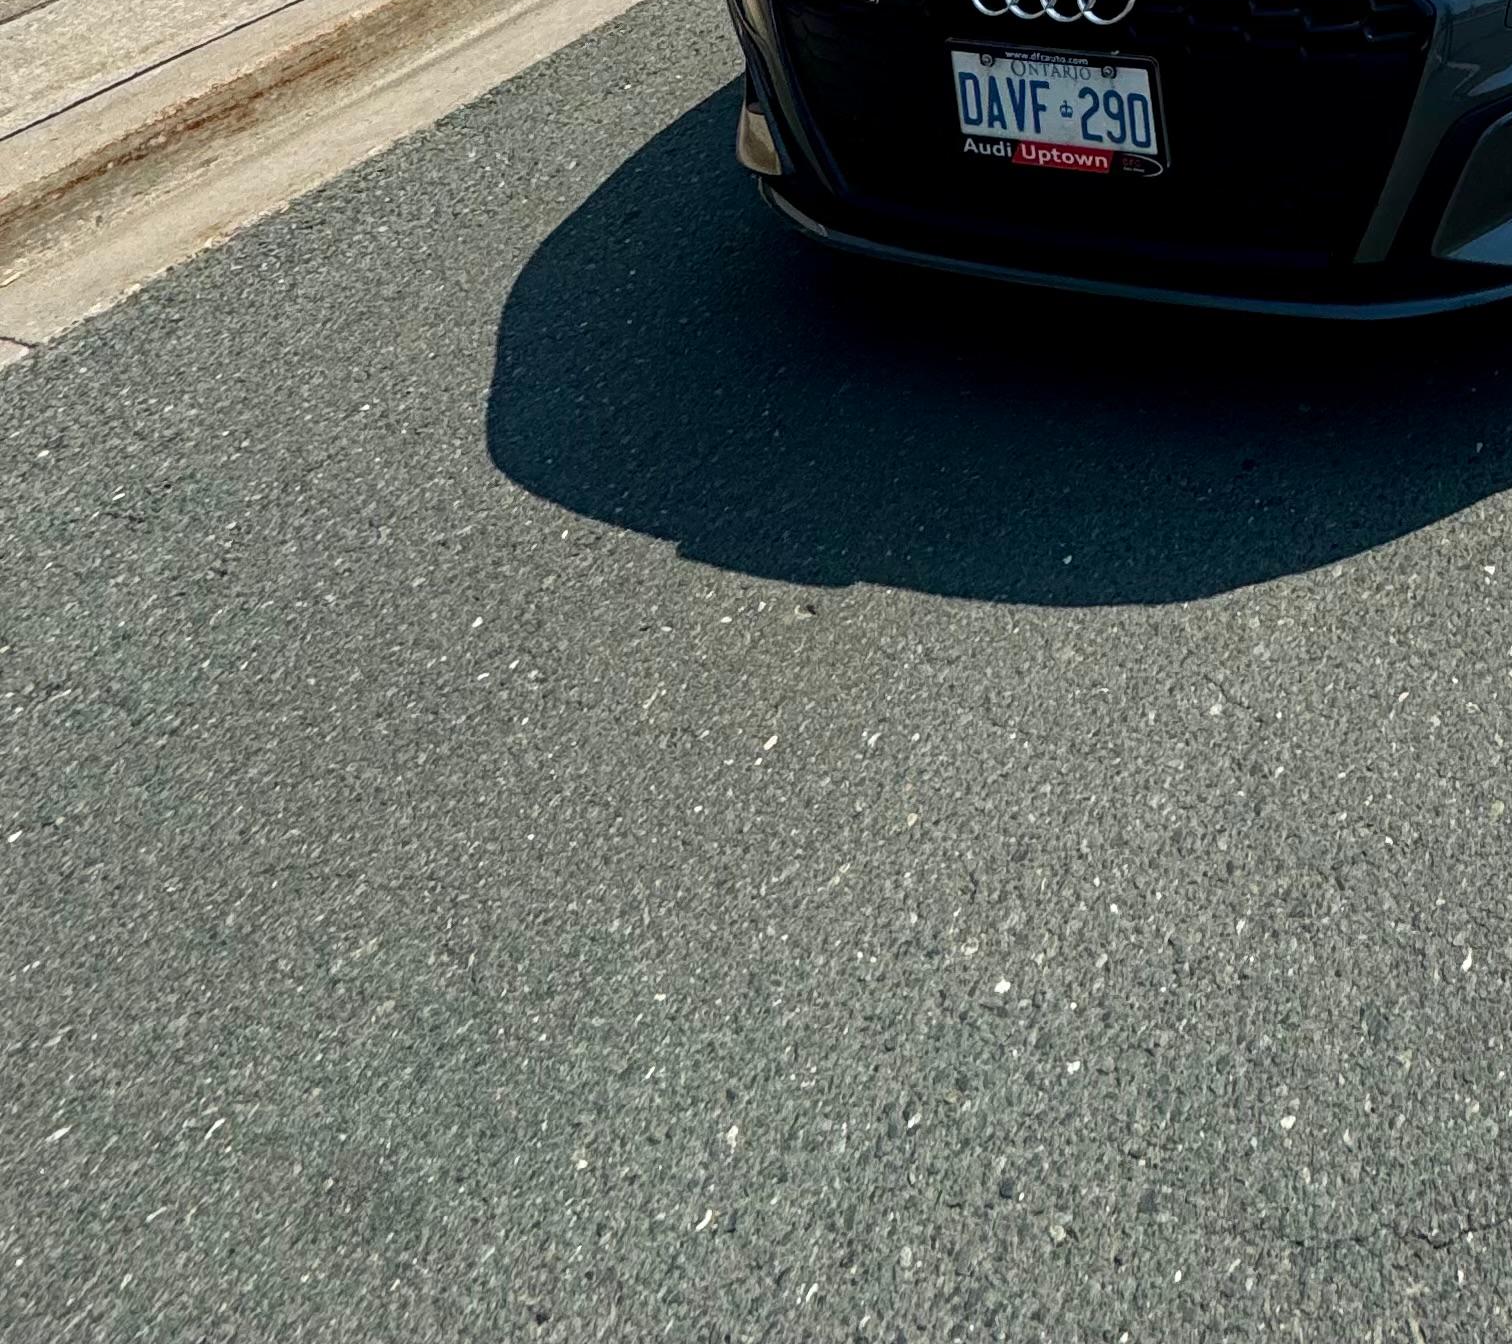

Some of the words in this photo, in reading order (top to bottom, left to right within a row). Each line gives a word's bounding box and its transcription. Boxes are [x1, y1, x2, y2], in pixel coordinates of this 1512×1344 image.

[1010, 59, 1092, 81] ONTARIO
[958, 71, 1051, 134] DAVF
[1078, 86, 1151, 148] 290
[963, 137, 1013, 158] Audi
[1021, 143, 1108, 169] Uptown
